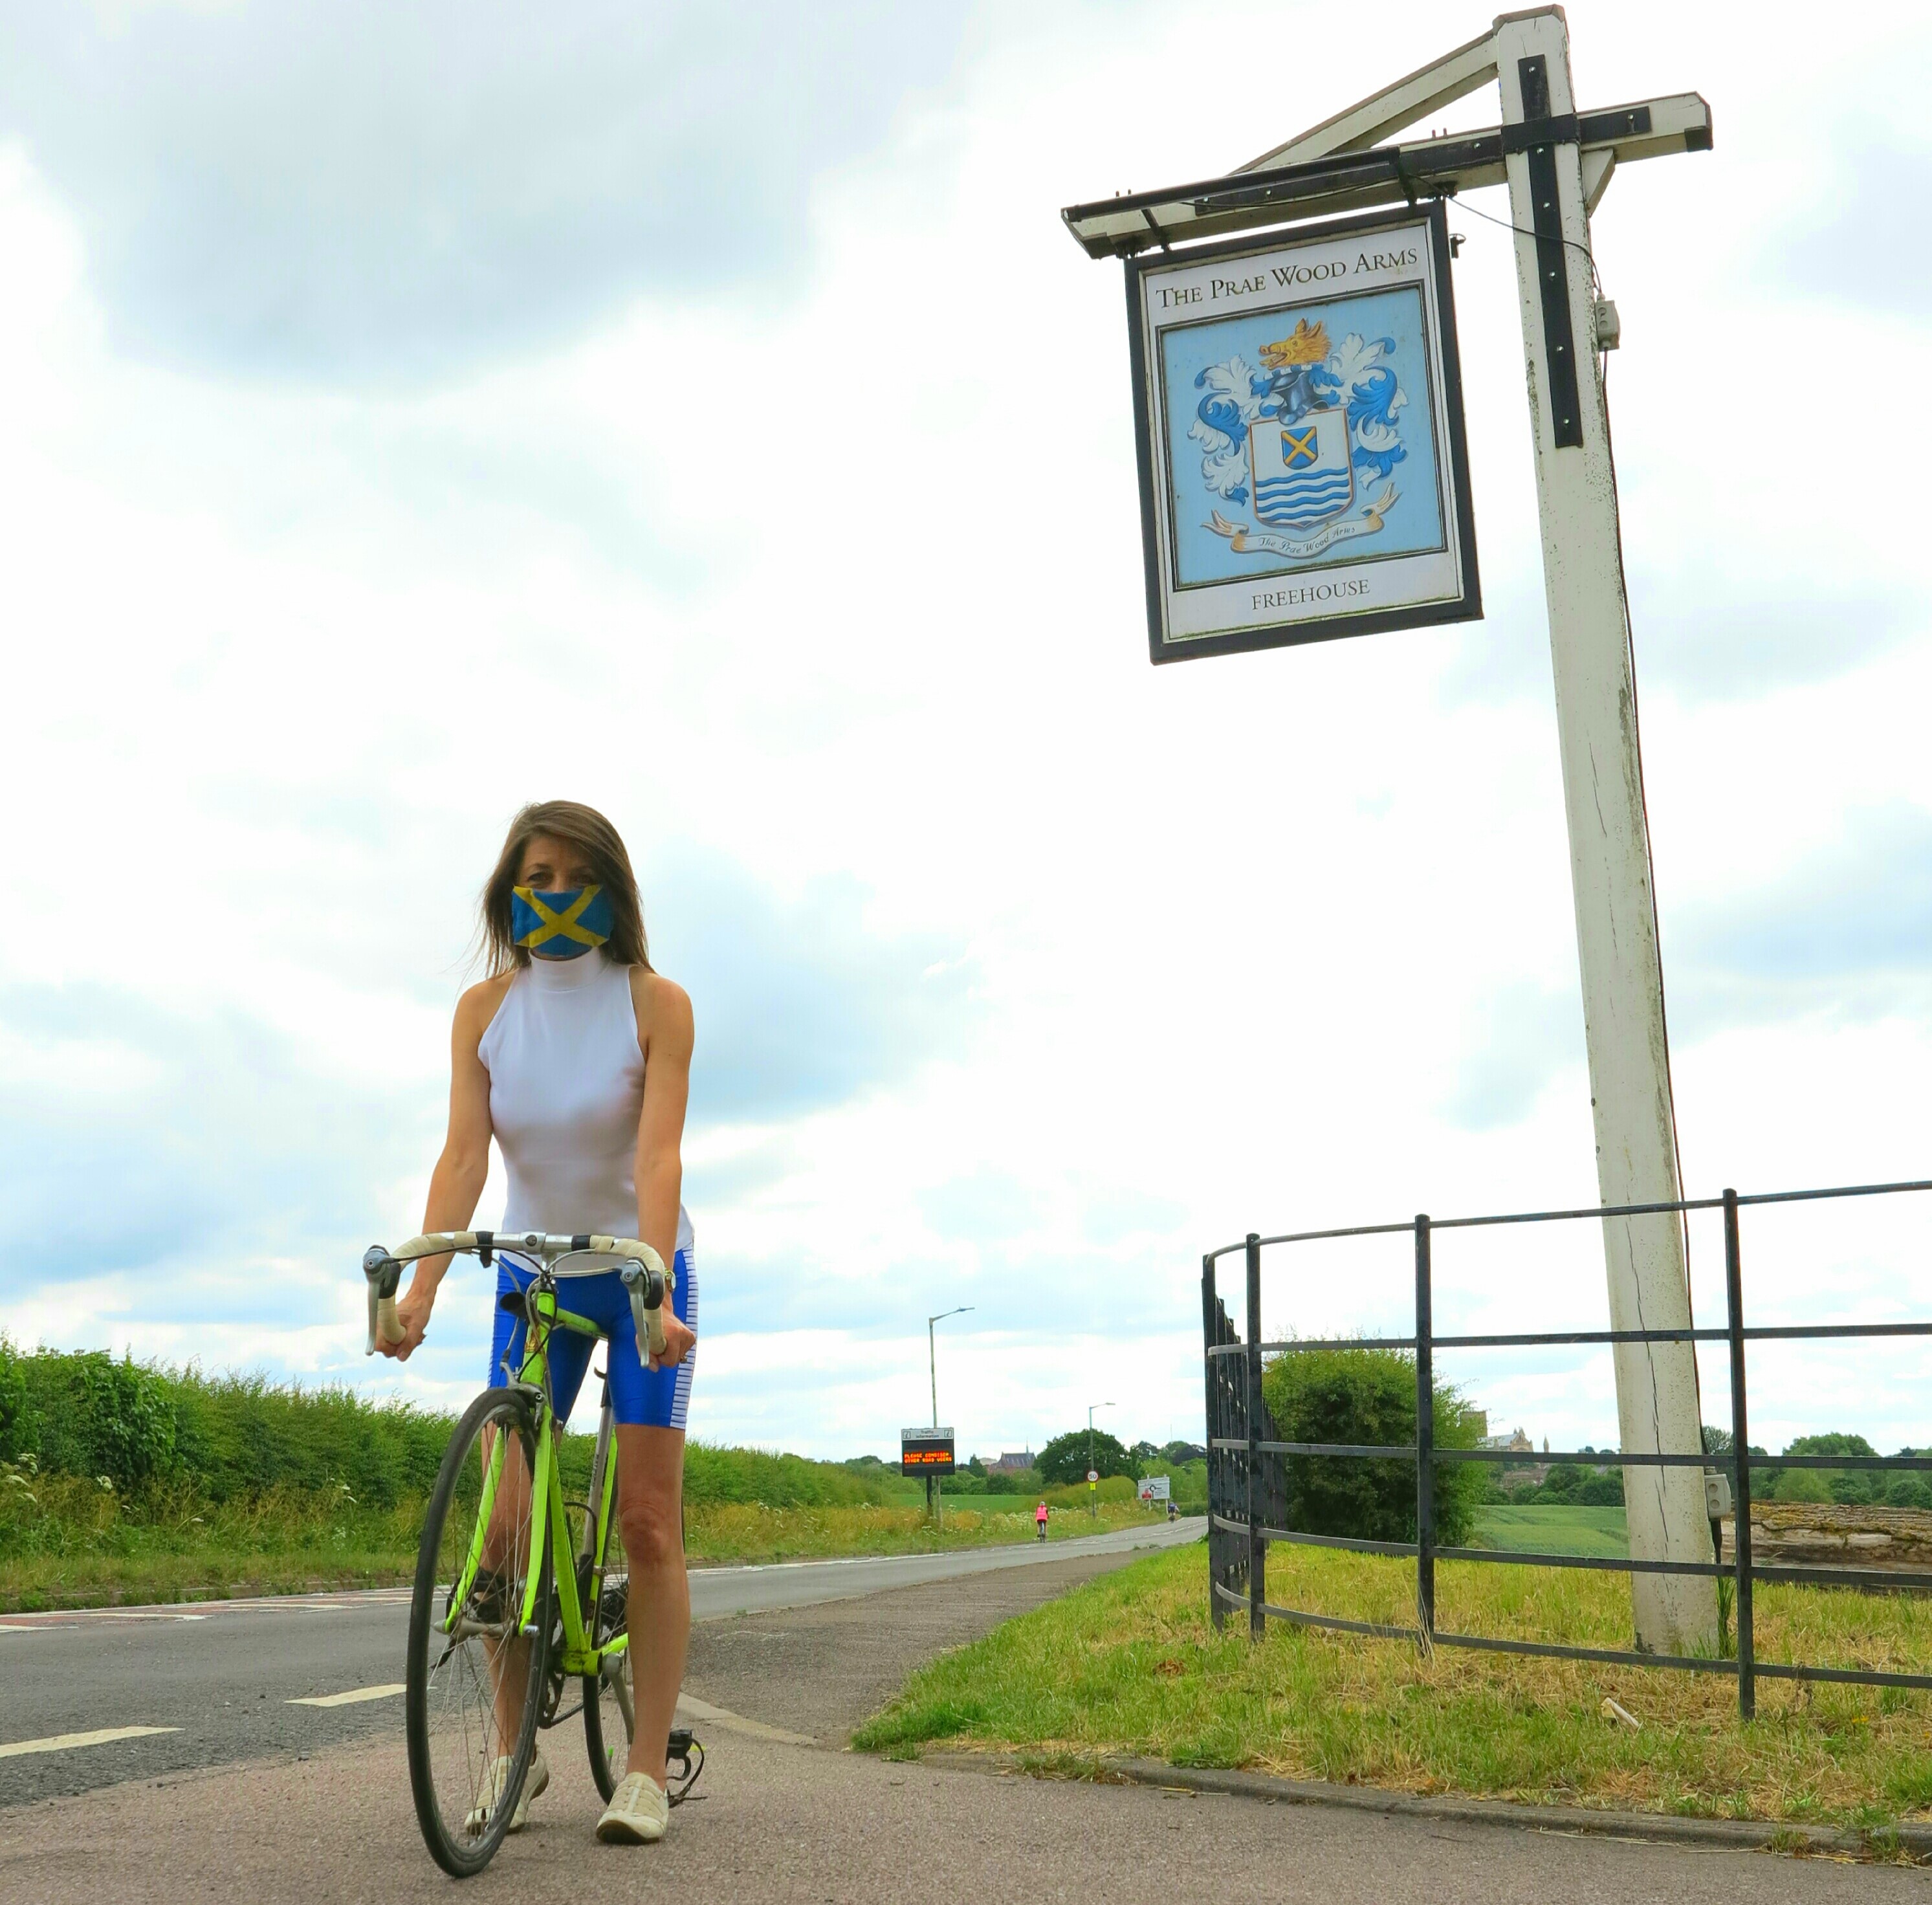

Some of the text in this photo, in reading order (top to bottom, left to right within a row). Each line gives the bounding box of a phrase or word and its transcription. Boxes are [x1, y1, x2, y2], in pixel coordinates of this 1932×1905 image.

[1156, 248, 1418, 308] THE PRAE WOOD ARMS
[1258, 527, 1356, 554] The Prae Wood Arms
[1251, 579, 1370, 611] FREEHOUSE
